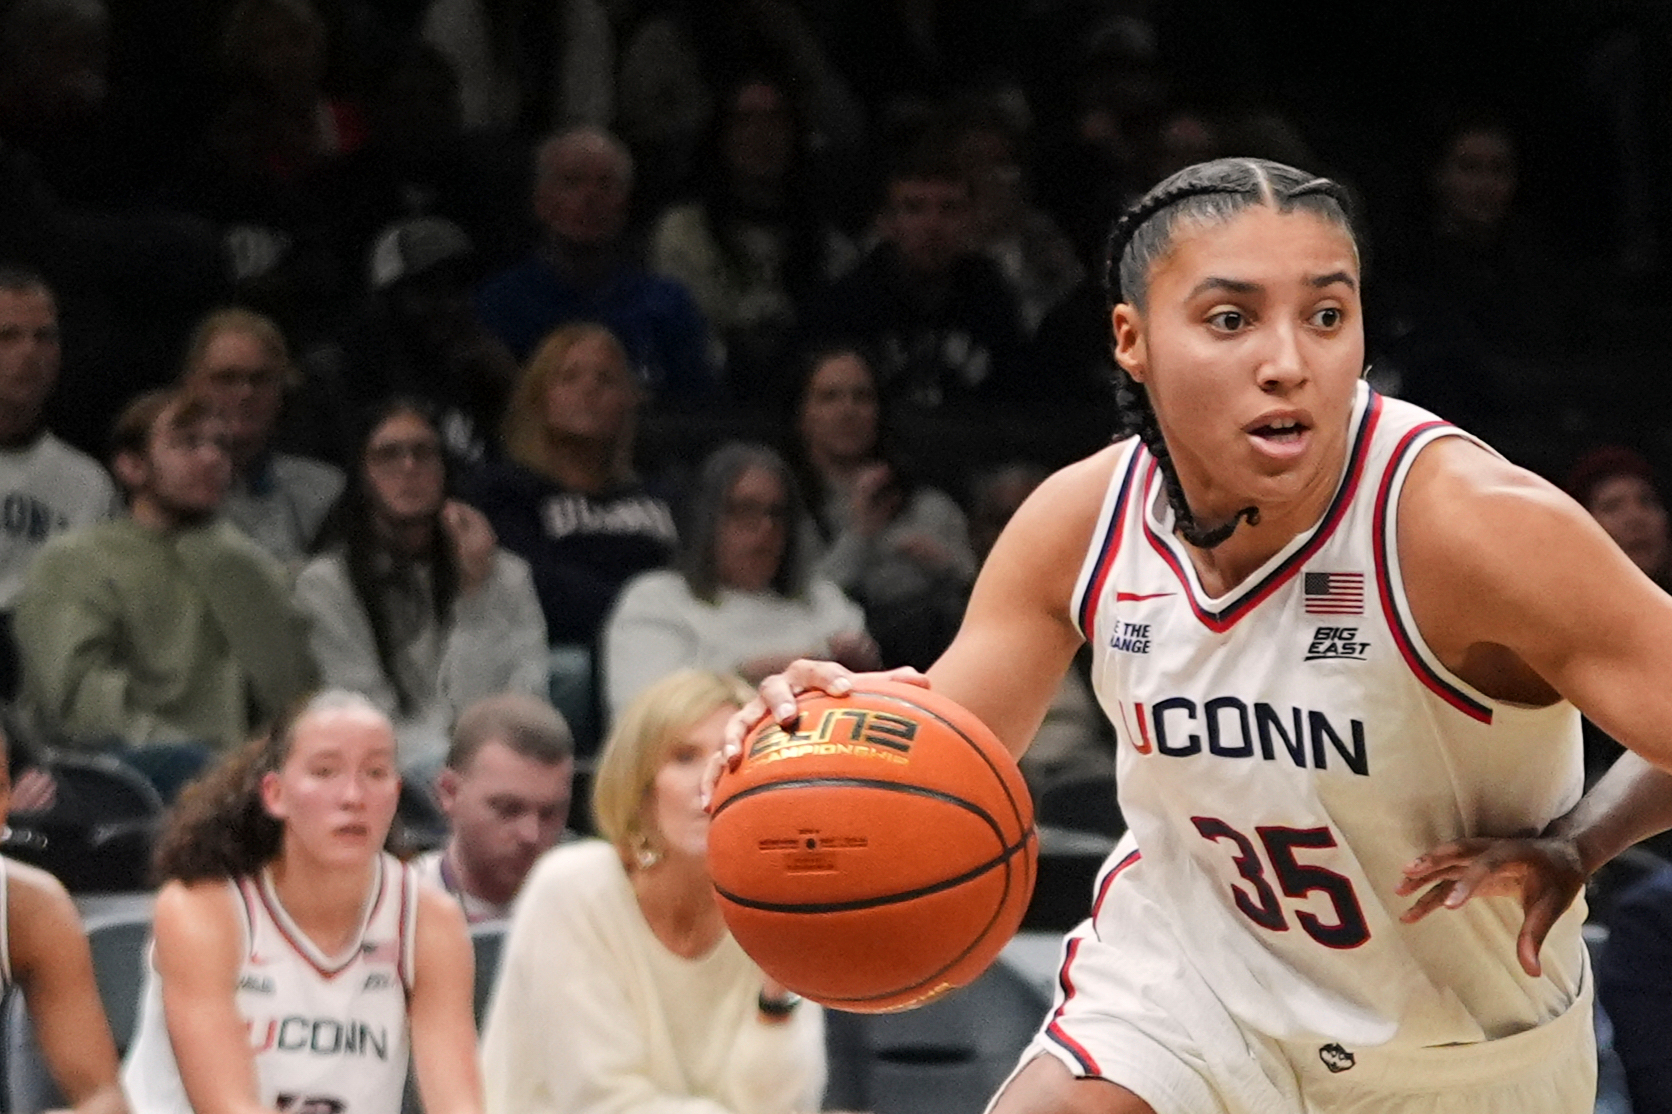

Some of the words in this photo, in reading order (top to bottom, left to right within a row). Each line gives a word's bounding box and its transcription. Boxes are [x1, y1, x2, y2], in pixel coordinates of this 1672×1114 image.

[1124, 622, 1151, 639] THE
[1313, 626, 1359, 642] BIG
[1307, 642, 1371, 656] EAST
[1119, 696, 1369, 776] UCONN
[1190, 815, 1372, 950] 35
